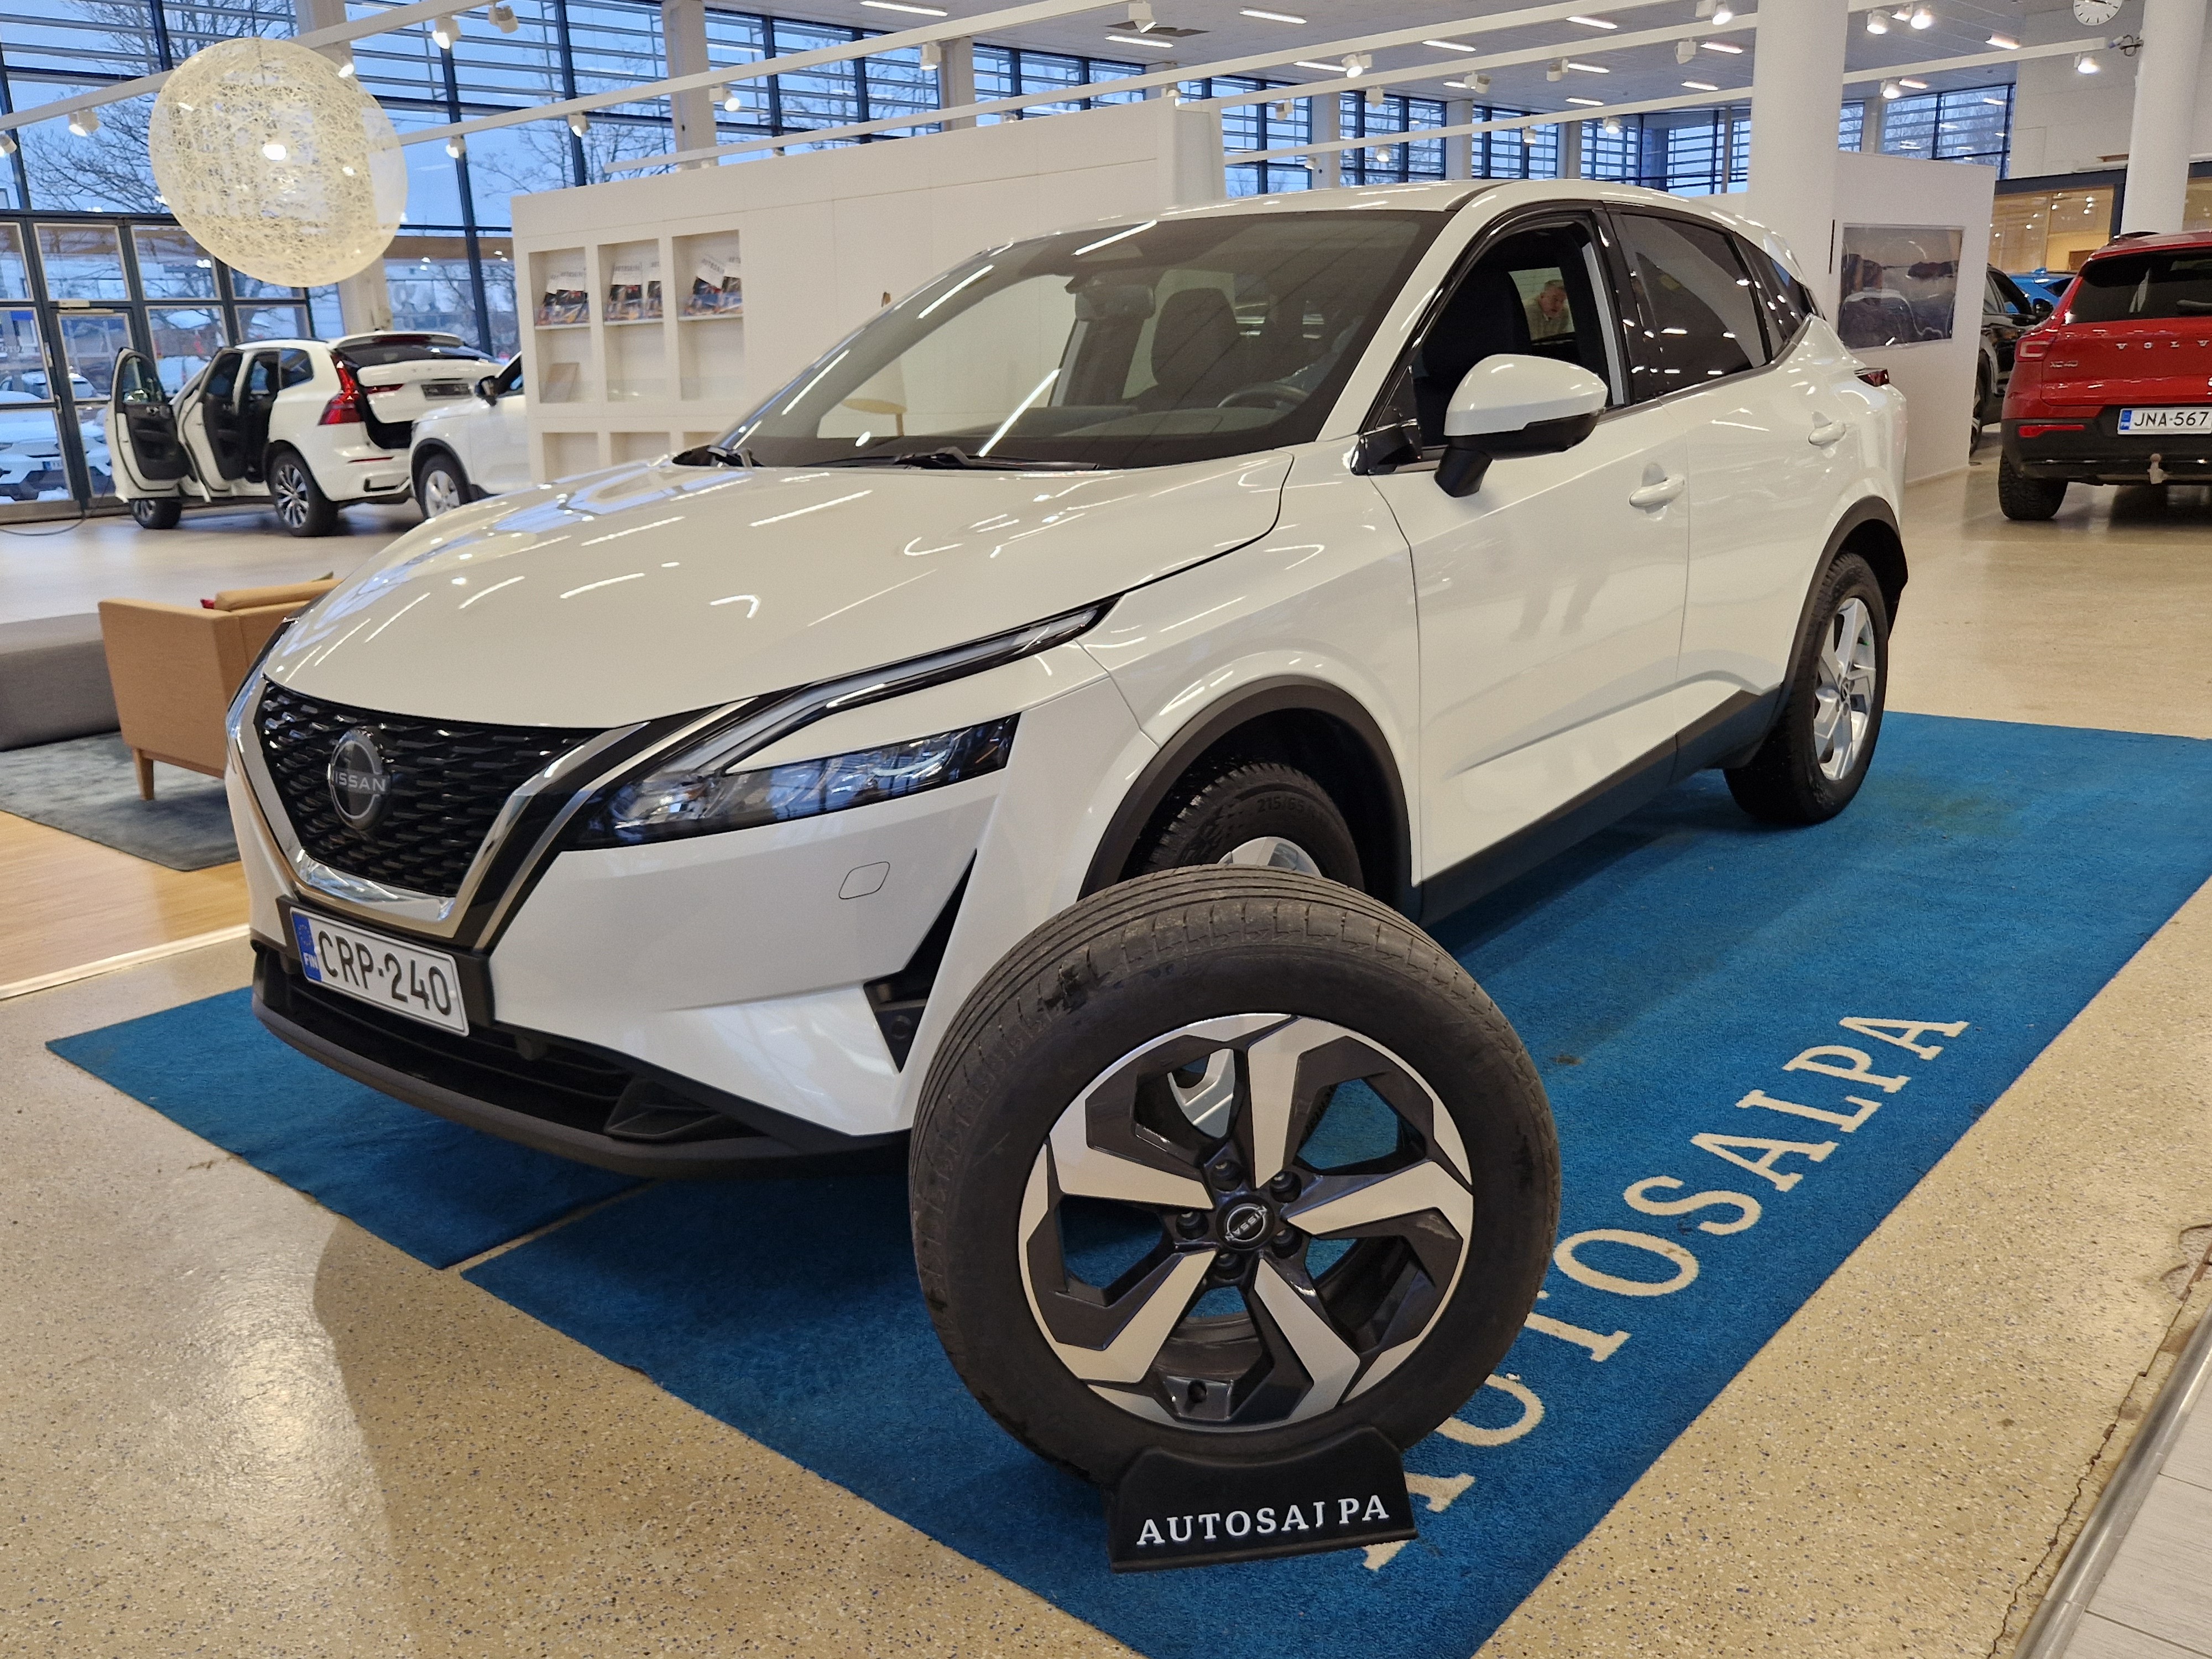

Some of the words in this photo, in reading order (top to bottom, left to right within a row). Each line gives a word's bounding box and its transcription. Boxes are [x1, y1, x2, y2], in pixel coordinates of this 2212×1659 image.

[2134, 411, 2209, 426] JNA-567
[303, 952, 319, 969] FIN
[318, 930, 451, 1016] CRP-240
[1225, 1205, 1267, 1241] NISSAN
